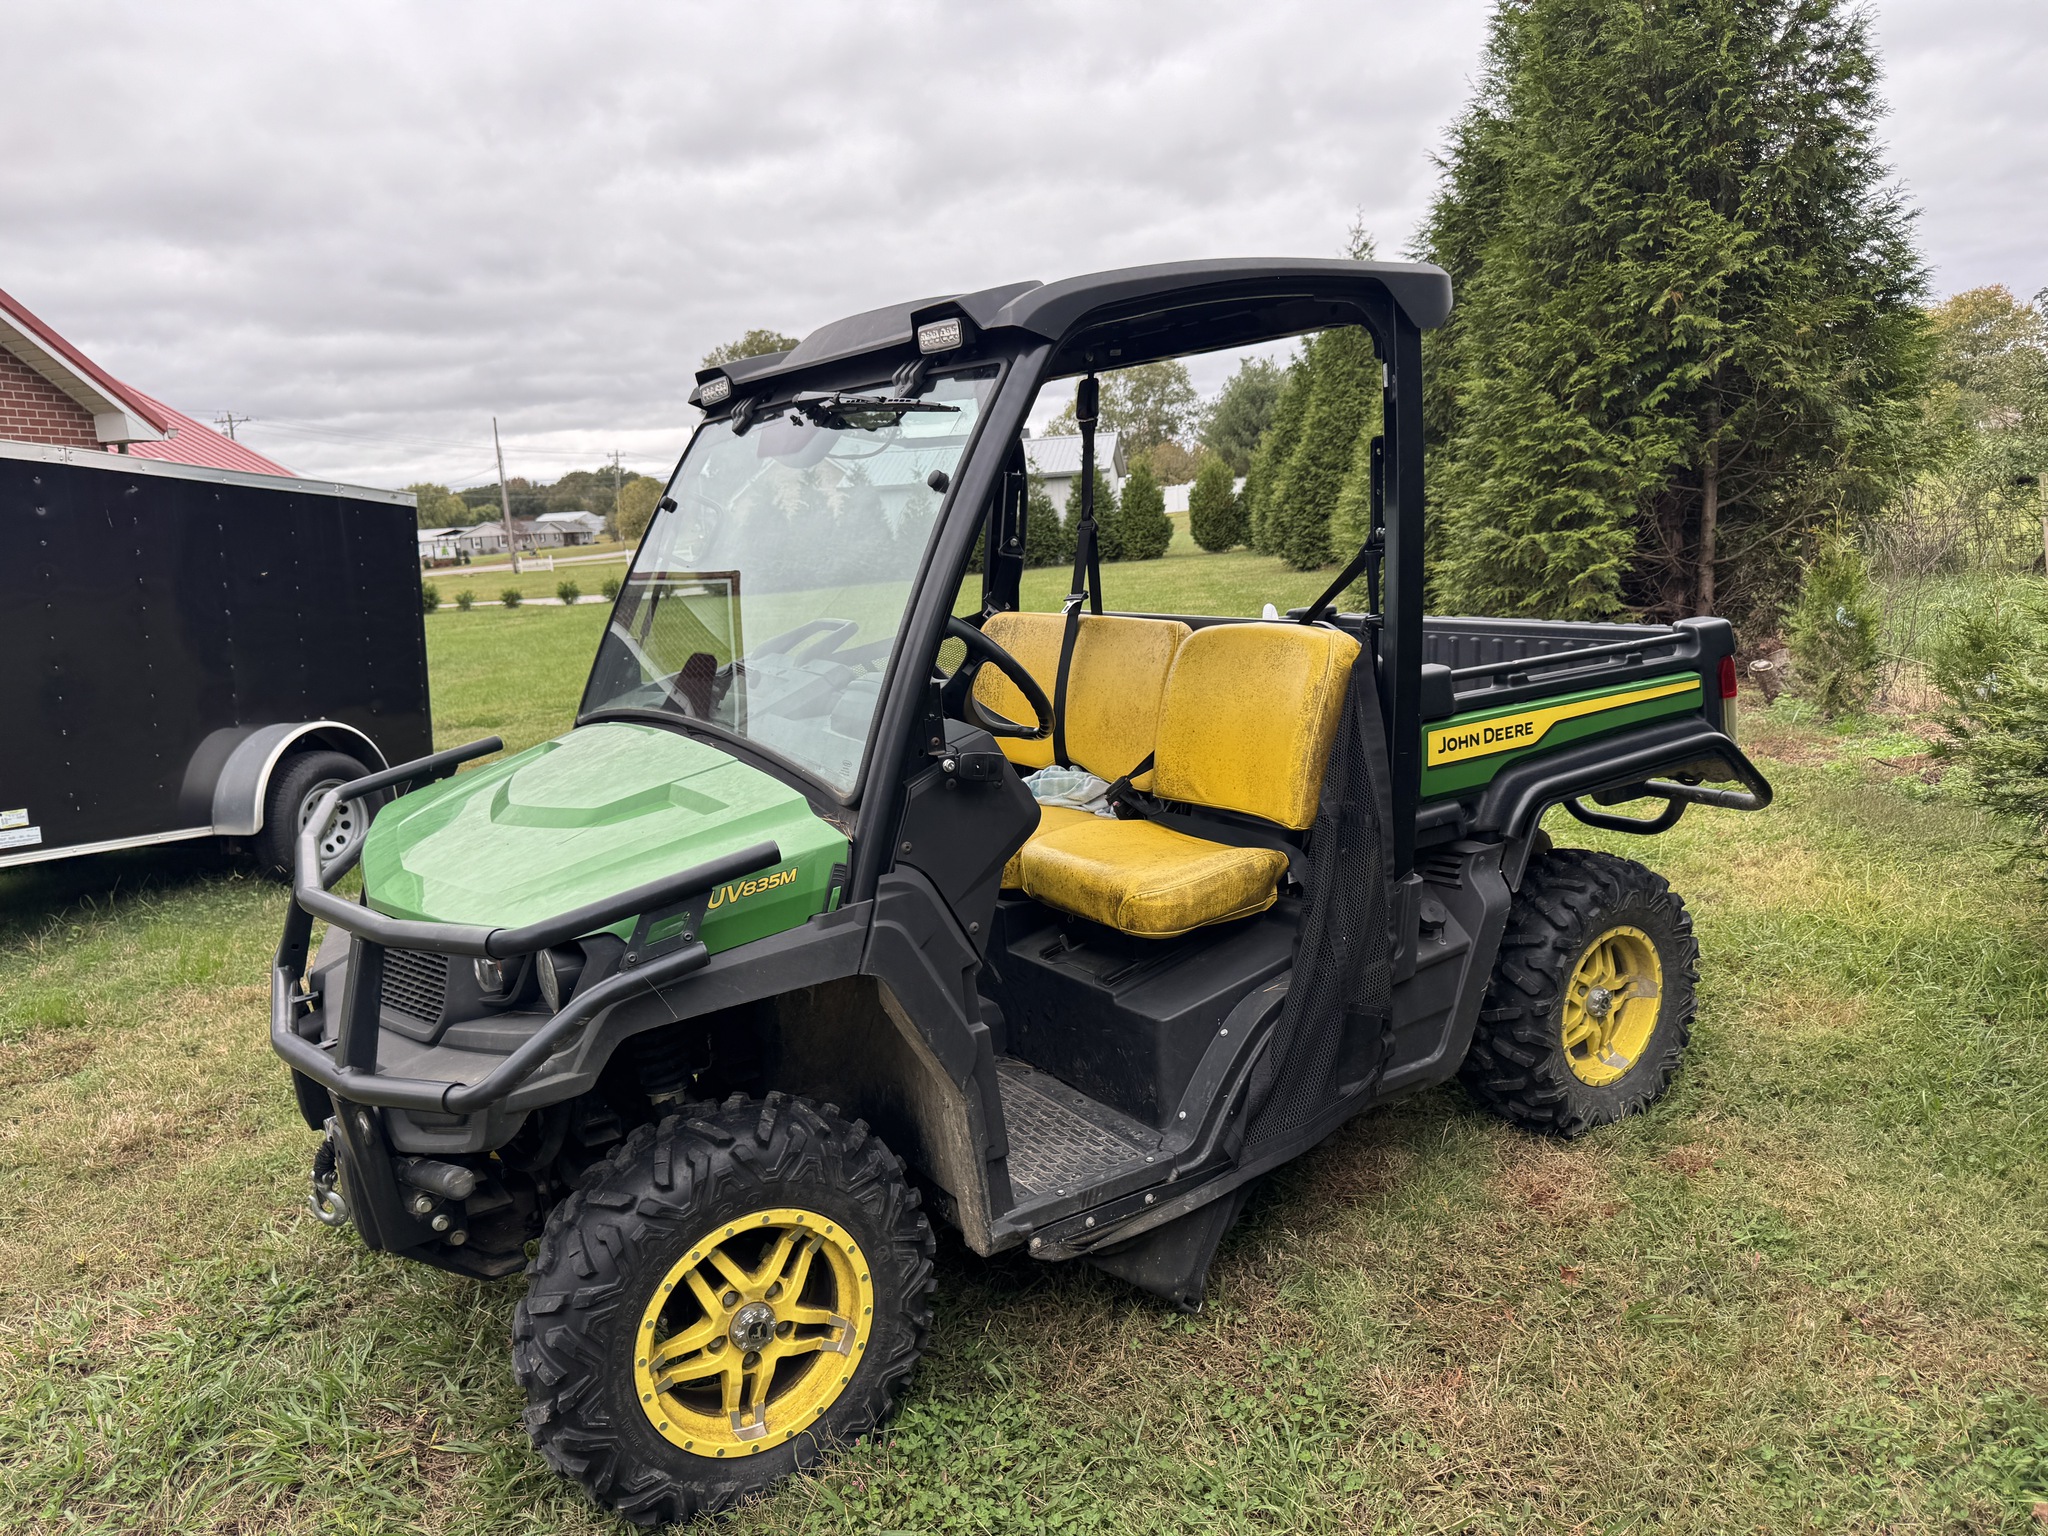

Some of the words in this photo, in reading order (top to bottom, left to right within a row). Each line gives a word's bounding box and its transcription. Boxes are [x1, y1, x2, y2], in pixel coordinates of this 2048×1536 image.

[1438, 732, 1480, 754] JOHN
[1484, 721, 1534, 744] DEERE
[707, 867, 798, 910] UV835M
